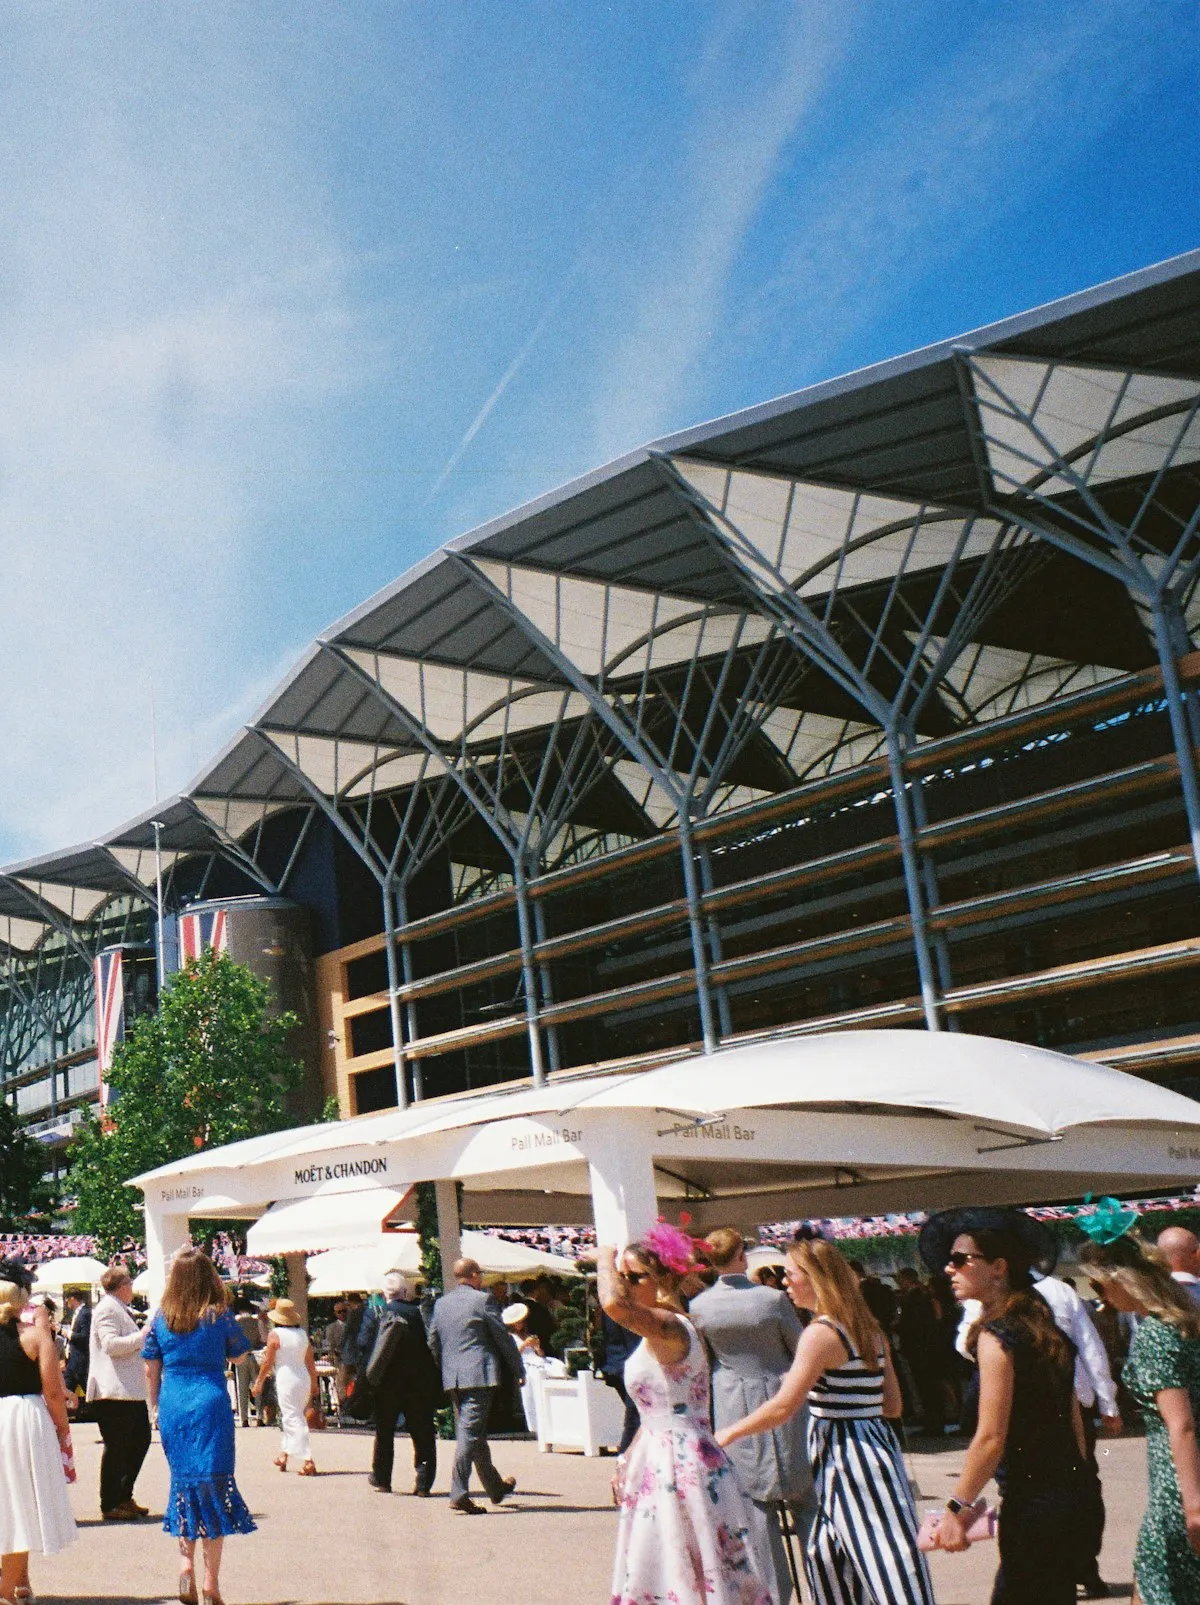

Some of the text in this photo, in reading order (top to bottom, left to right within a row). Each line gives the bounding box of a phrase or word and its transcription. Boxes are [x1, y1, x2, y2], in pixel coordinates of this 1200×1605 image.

[511, 1128, 583, 1150] Pall Mall Bar
[701, 1123, 730, 1140] Mall
[734, 1125, 756, 1140] Bar
[295, 1158, 387, 1184] MOËT & CHANDON
[161, 1186, 204, 1201] Pall Mall Bar
